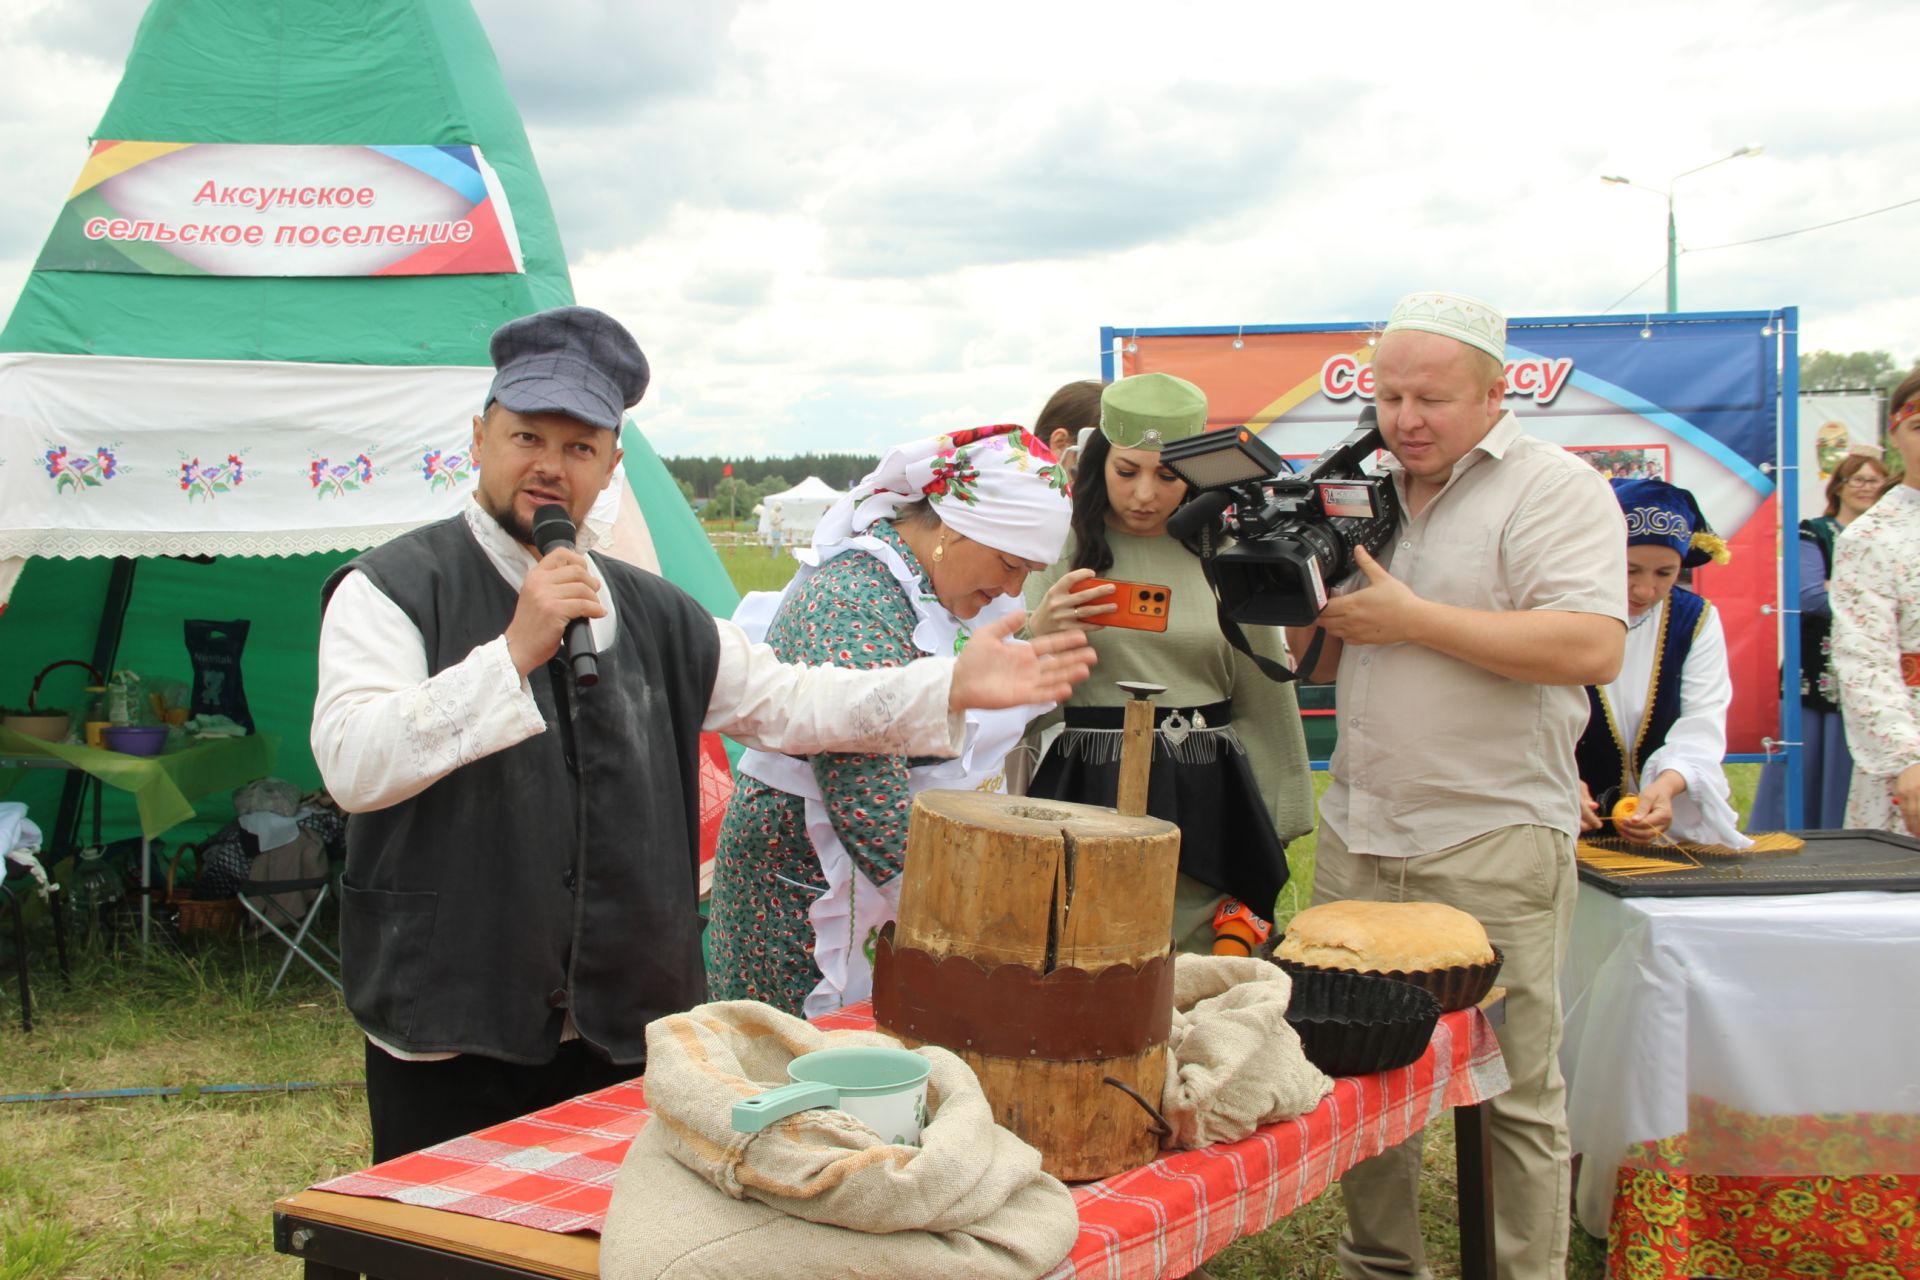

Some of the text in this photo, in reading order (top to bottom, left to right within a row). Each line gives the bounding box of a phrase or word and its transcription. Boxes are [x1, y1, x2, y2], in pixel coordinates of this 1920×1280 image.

[192, 180, 376, 211] Аксунское
[84, 217, 474, 246] сельское поселение
[1321, 355, 1377, 397] Се
